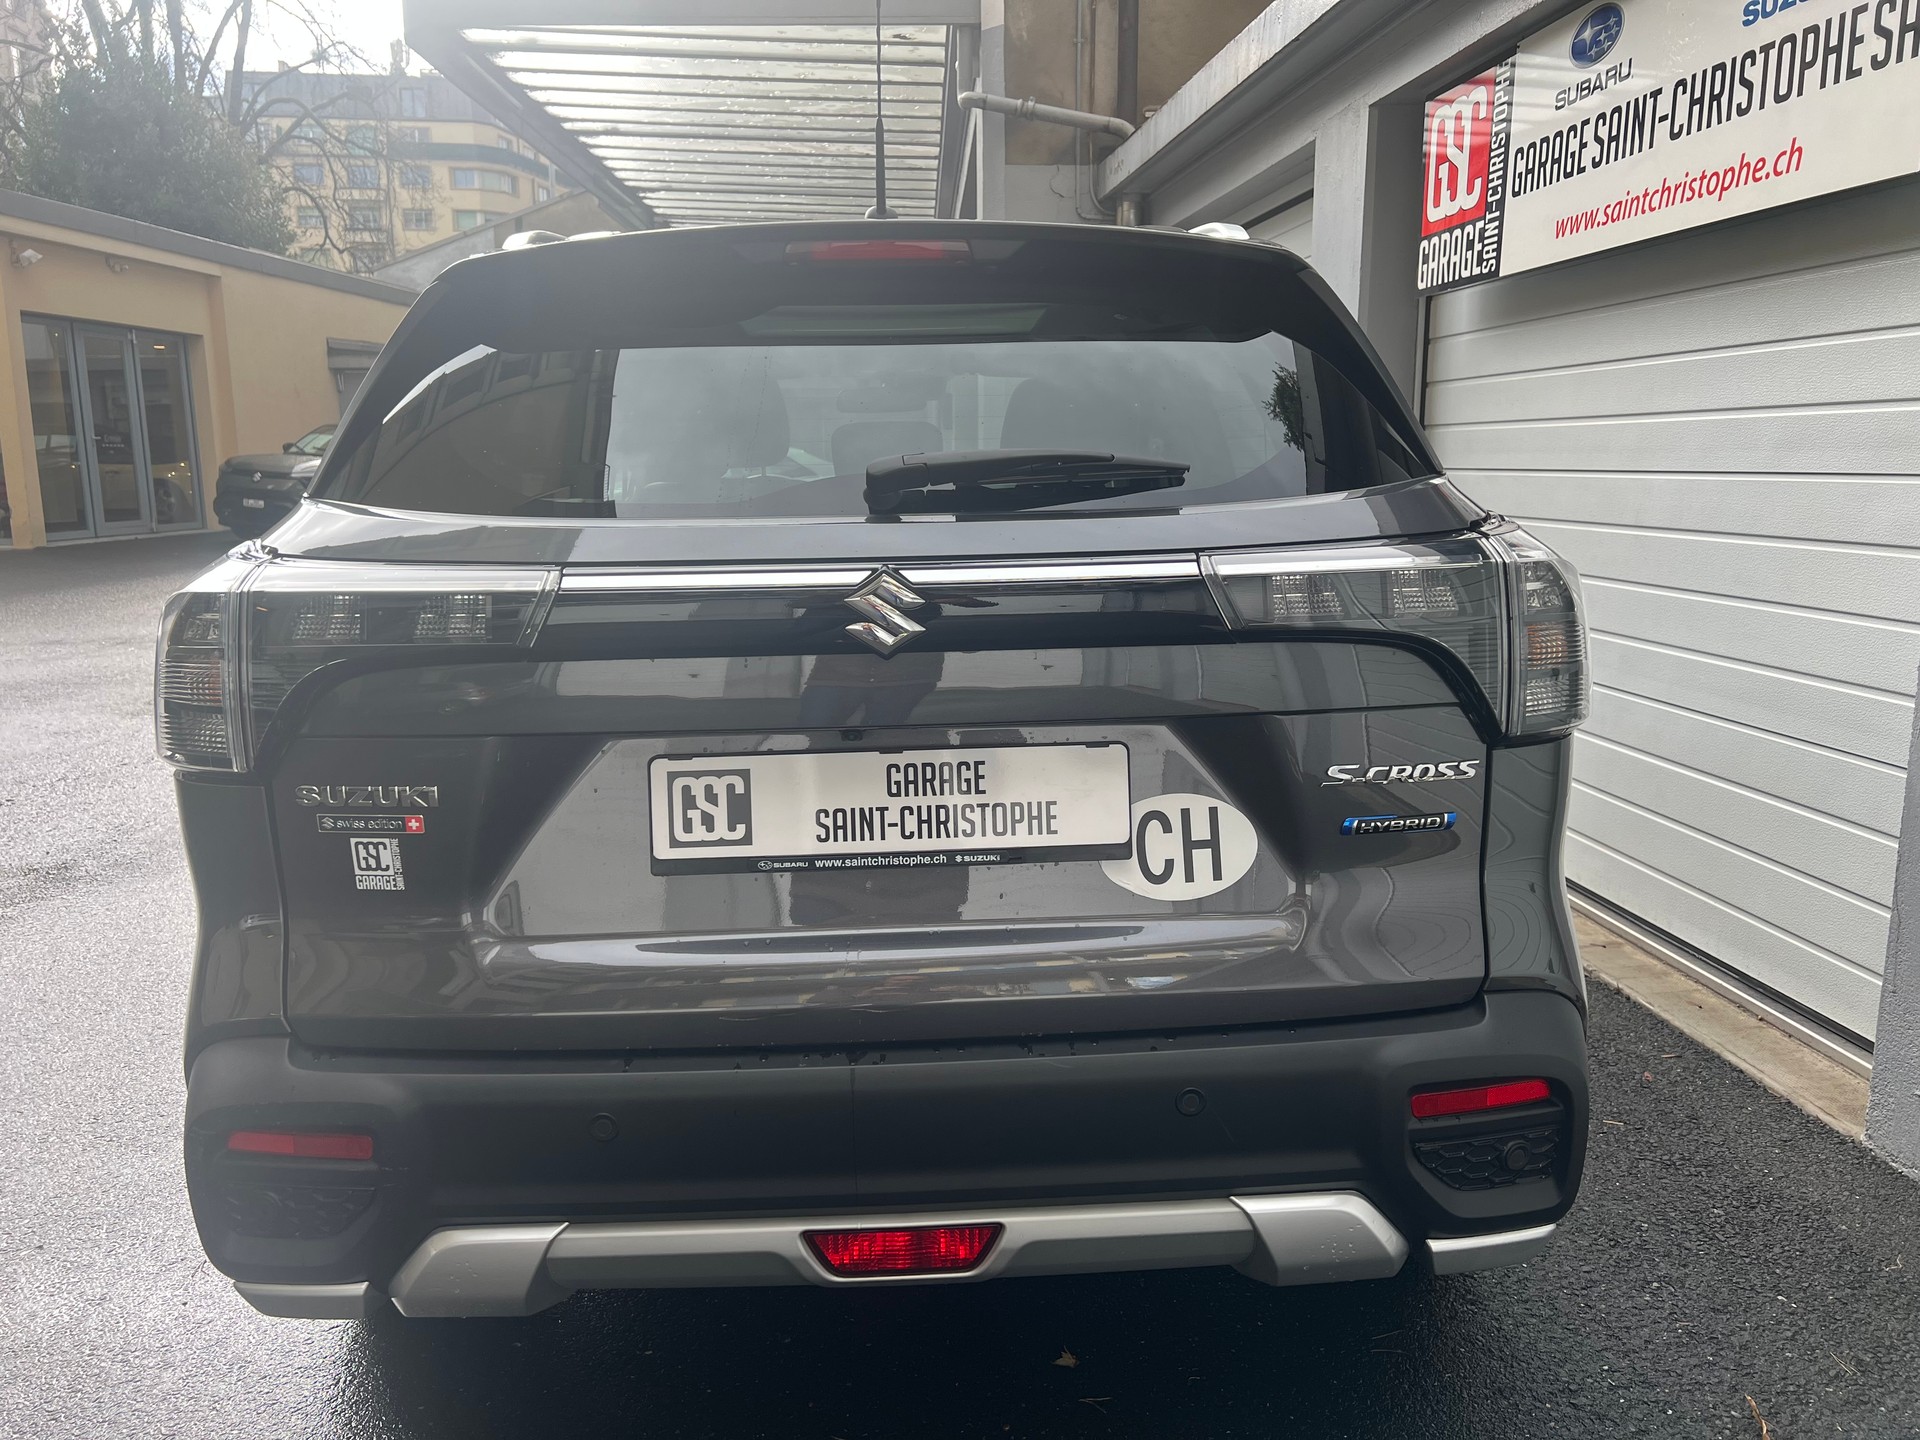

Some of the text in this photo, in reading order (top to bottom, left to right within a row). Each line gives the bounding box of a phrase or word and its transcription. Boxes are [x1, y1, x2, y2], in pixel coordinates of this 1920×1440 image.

[1511, 117, 1591, 198] GARAGE
[1591, 2, 1869, 170] SAINT-CHRISTOPHE
[1554, 57, 1633, 112] SUBARU
[1481, 57, 1512, 274] SAINT-CHRISTOPHE
[1555, 136, 1803, 239] www.saintchristophe.ch
[1417, 220, 1487, 291] GARAGE
[886, 761, 987, 798] GARAGE
[1320, 760, 1480, 788] S-CROSS
[295, 785, 439, 807] SUZUKI
[672, 776, 747, 842] GSC
[336, 818, 402, 829] swiss edition
[815, 801, 1058, 844] SAINT-CHRISTOPHE
[1360, 817, 1441, 834] HYBRID
[814, 855, 947, 868] www.saintchristophe.ch
[1136, 806, 1223, 885] CH
[355, 876, 397, 890] GARAGE
